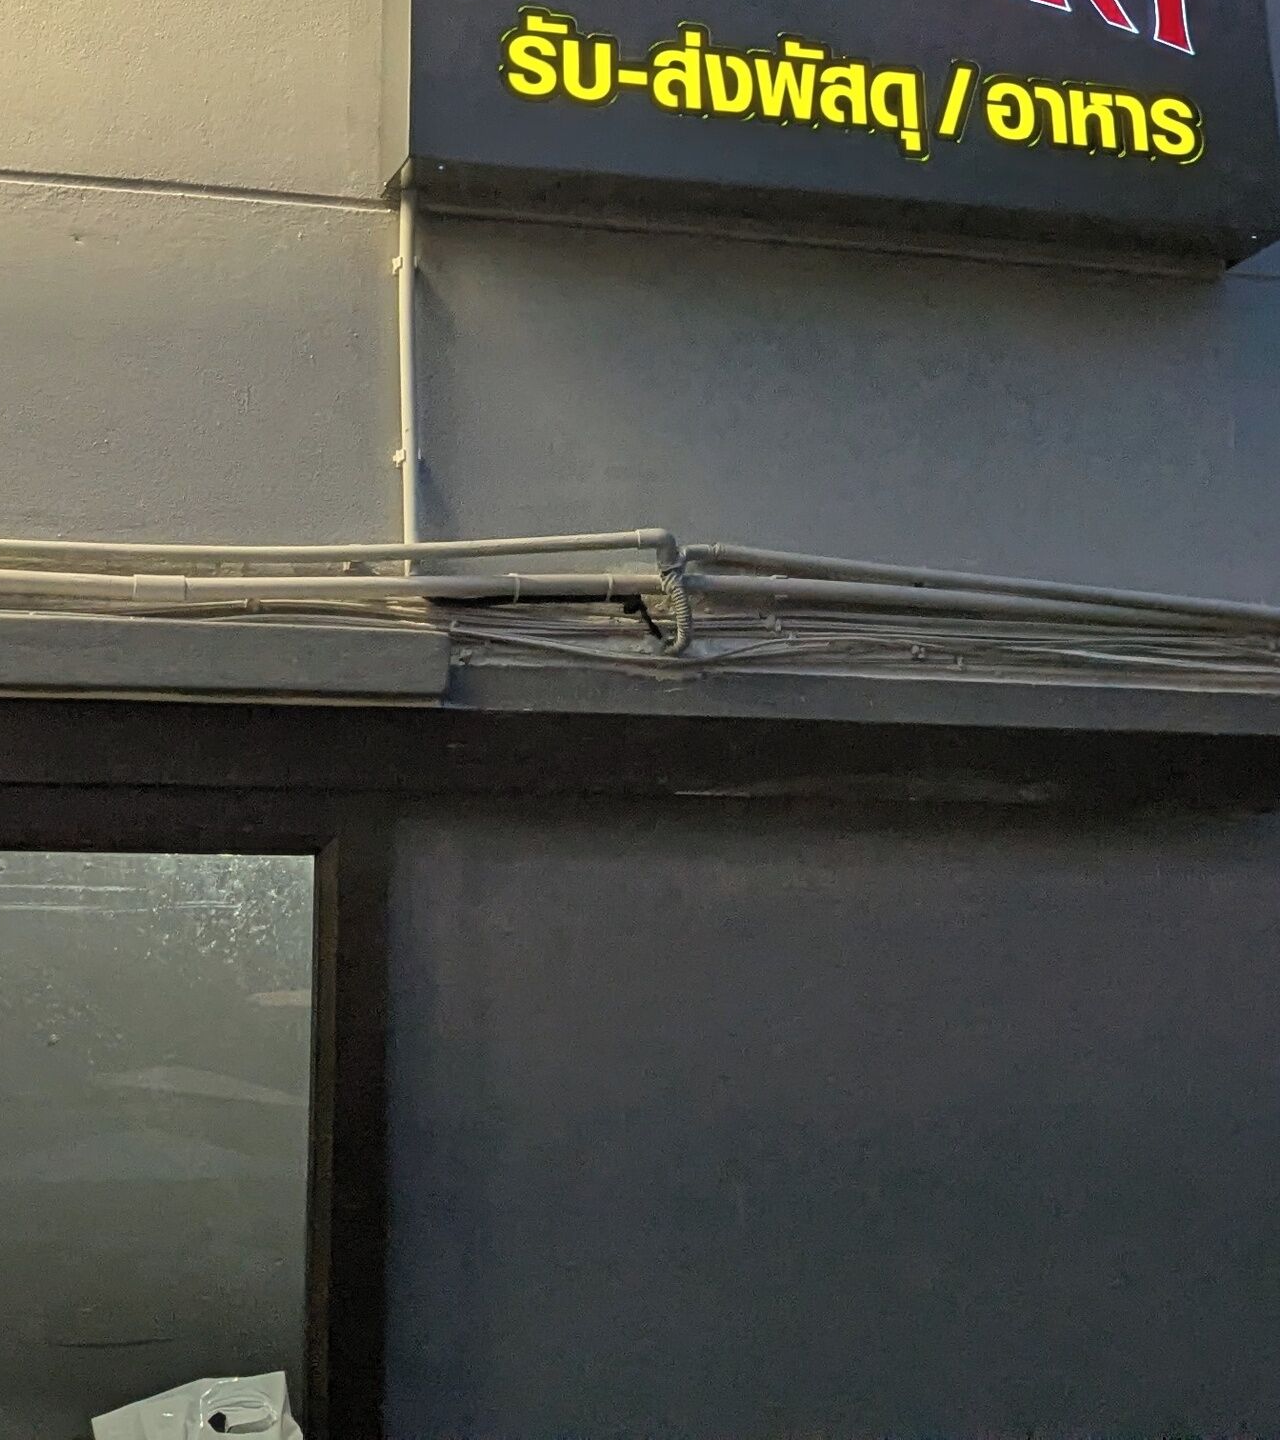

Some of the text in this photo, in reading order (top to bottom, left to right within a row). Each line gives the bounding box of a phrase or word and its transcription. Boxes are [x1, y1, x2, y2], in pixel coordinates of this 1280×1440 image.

[507, 13, 922, 152] รับ-ส่งพัสดุ
[986, 81, 1196, 157] อาหาร
